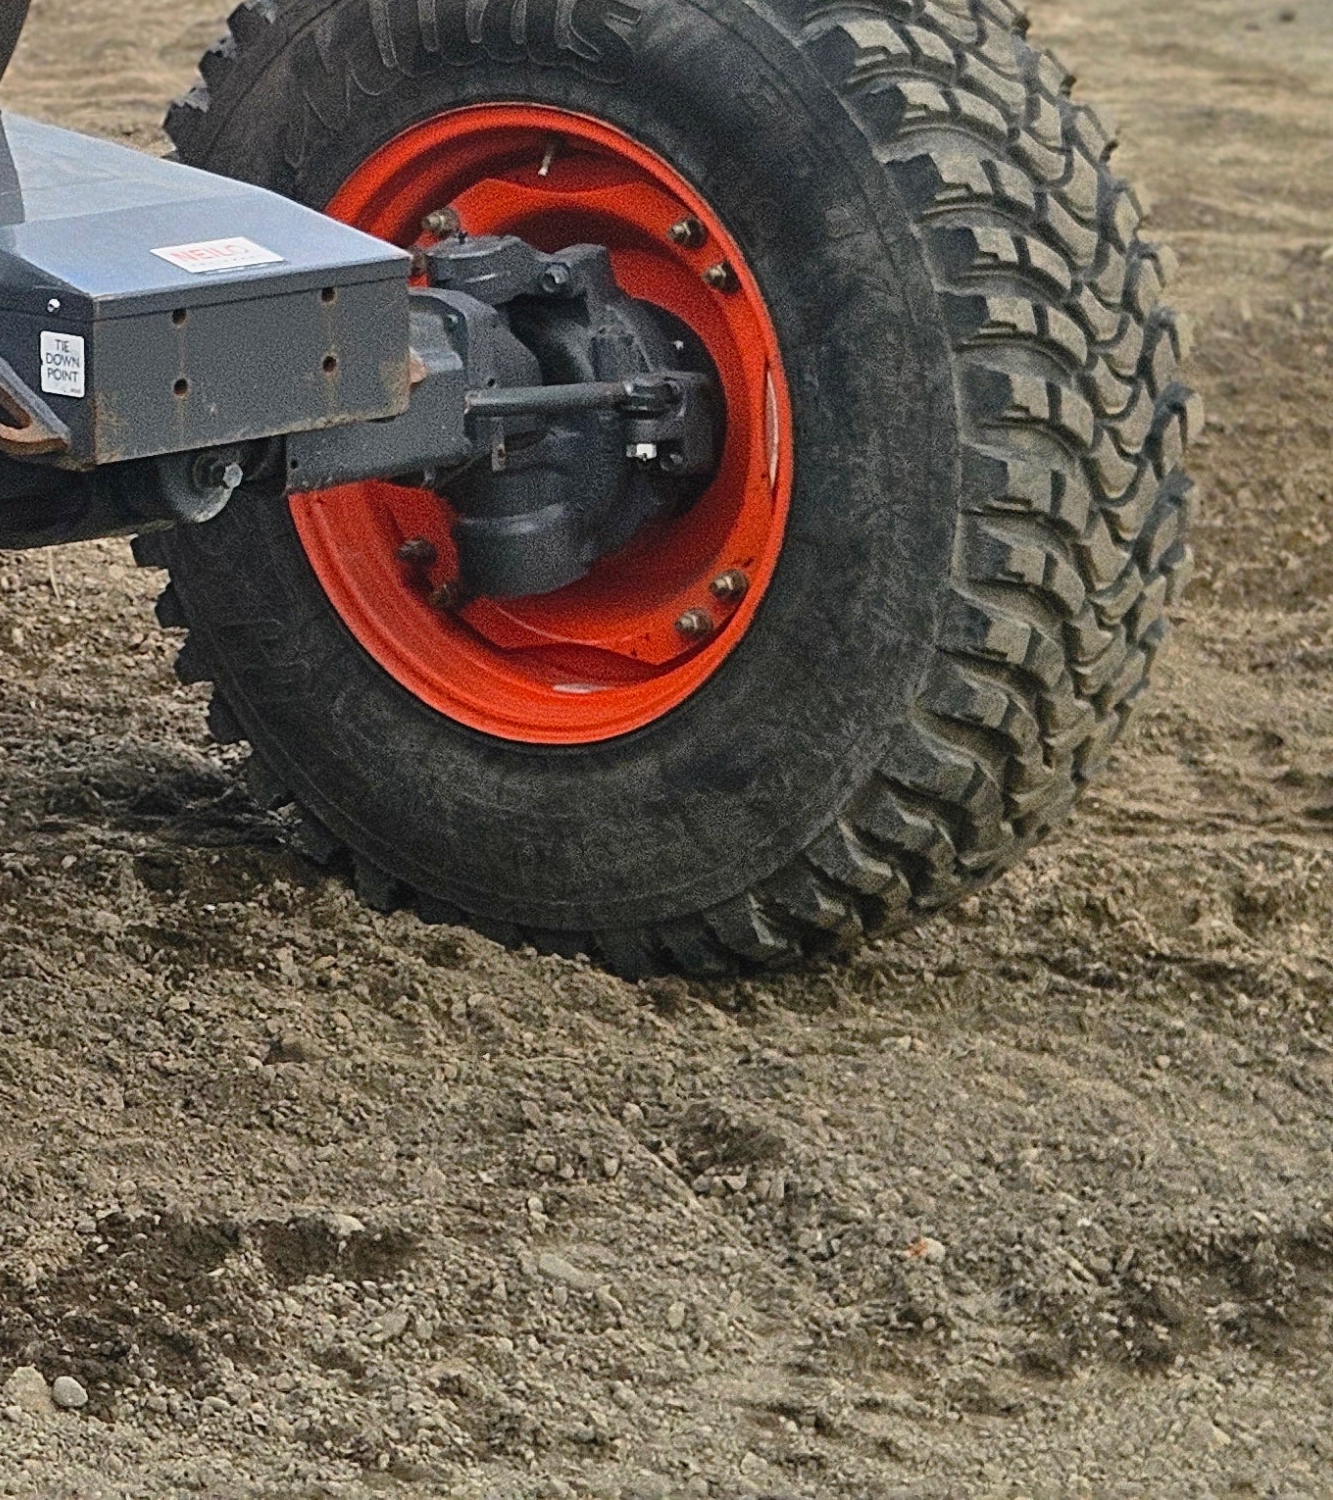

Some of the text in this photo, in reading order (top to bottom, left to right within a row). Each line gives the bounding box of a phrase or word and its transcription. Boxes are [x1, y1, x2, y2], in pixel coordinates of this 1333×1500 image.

[54, 339, 69, 353] TIE
[45, 351, 80, 369] DOWN
[47, 367, 79, 383] POINT
